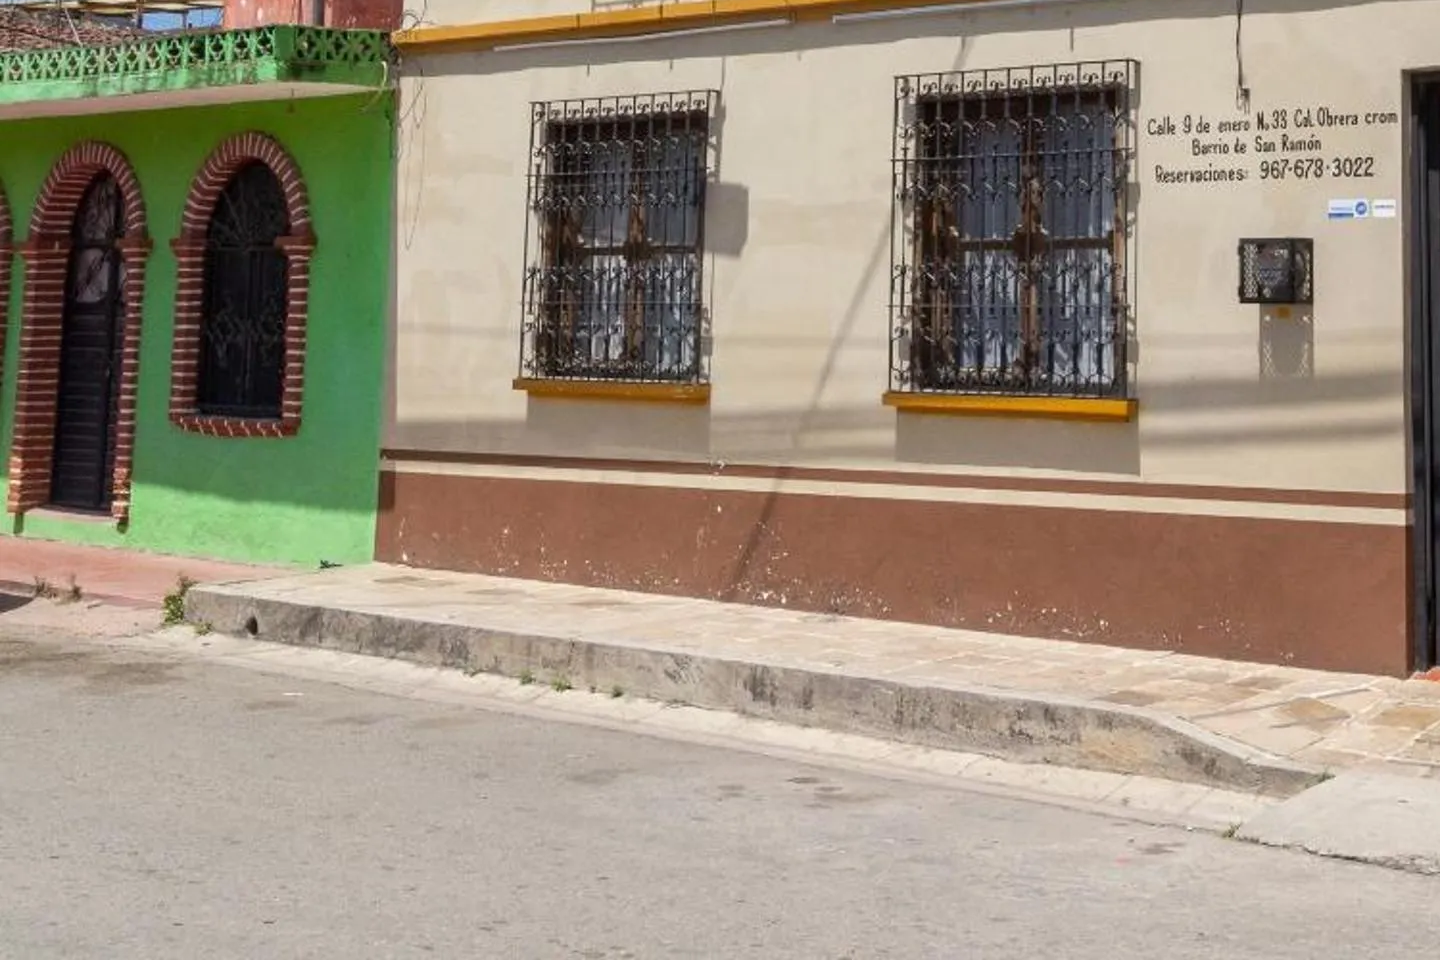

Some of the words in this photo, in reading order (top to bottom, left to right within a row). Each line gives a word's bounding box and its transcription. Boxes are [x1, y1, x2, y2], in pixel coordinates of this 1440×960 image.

[1147, 116, 1176, 135] Calle
[1182, 114, 1191, 133] 9
[1195, 115, 1210, 133] de
[1218, 120, 1250, 133] enero
[1316, 107, 1359, 127] Obrera
[1364, 112, 1399, 125] crom
[1192, 138, 1230, 156] Barrio
[1234, 137, 1247, 154] de
[1254, 135, 1276, 153] San
[1281, 133, 1322, 153] Ramón
